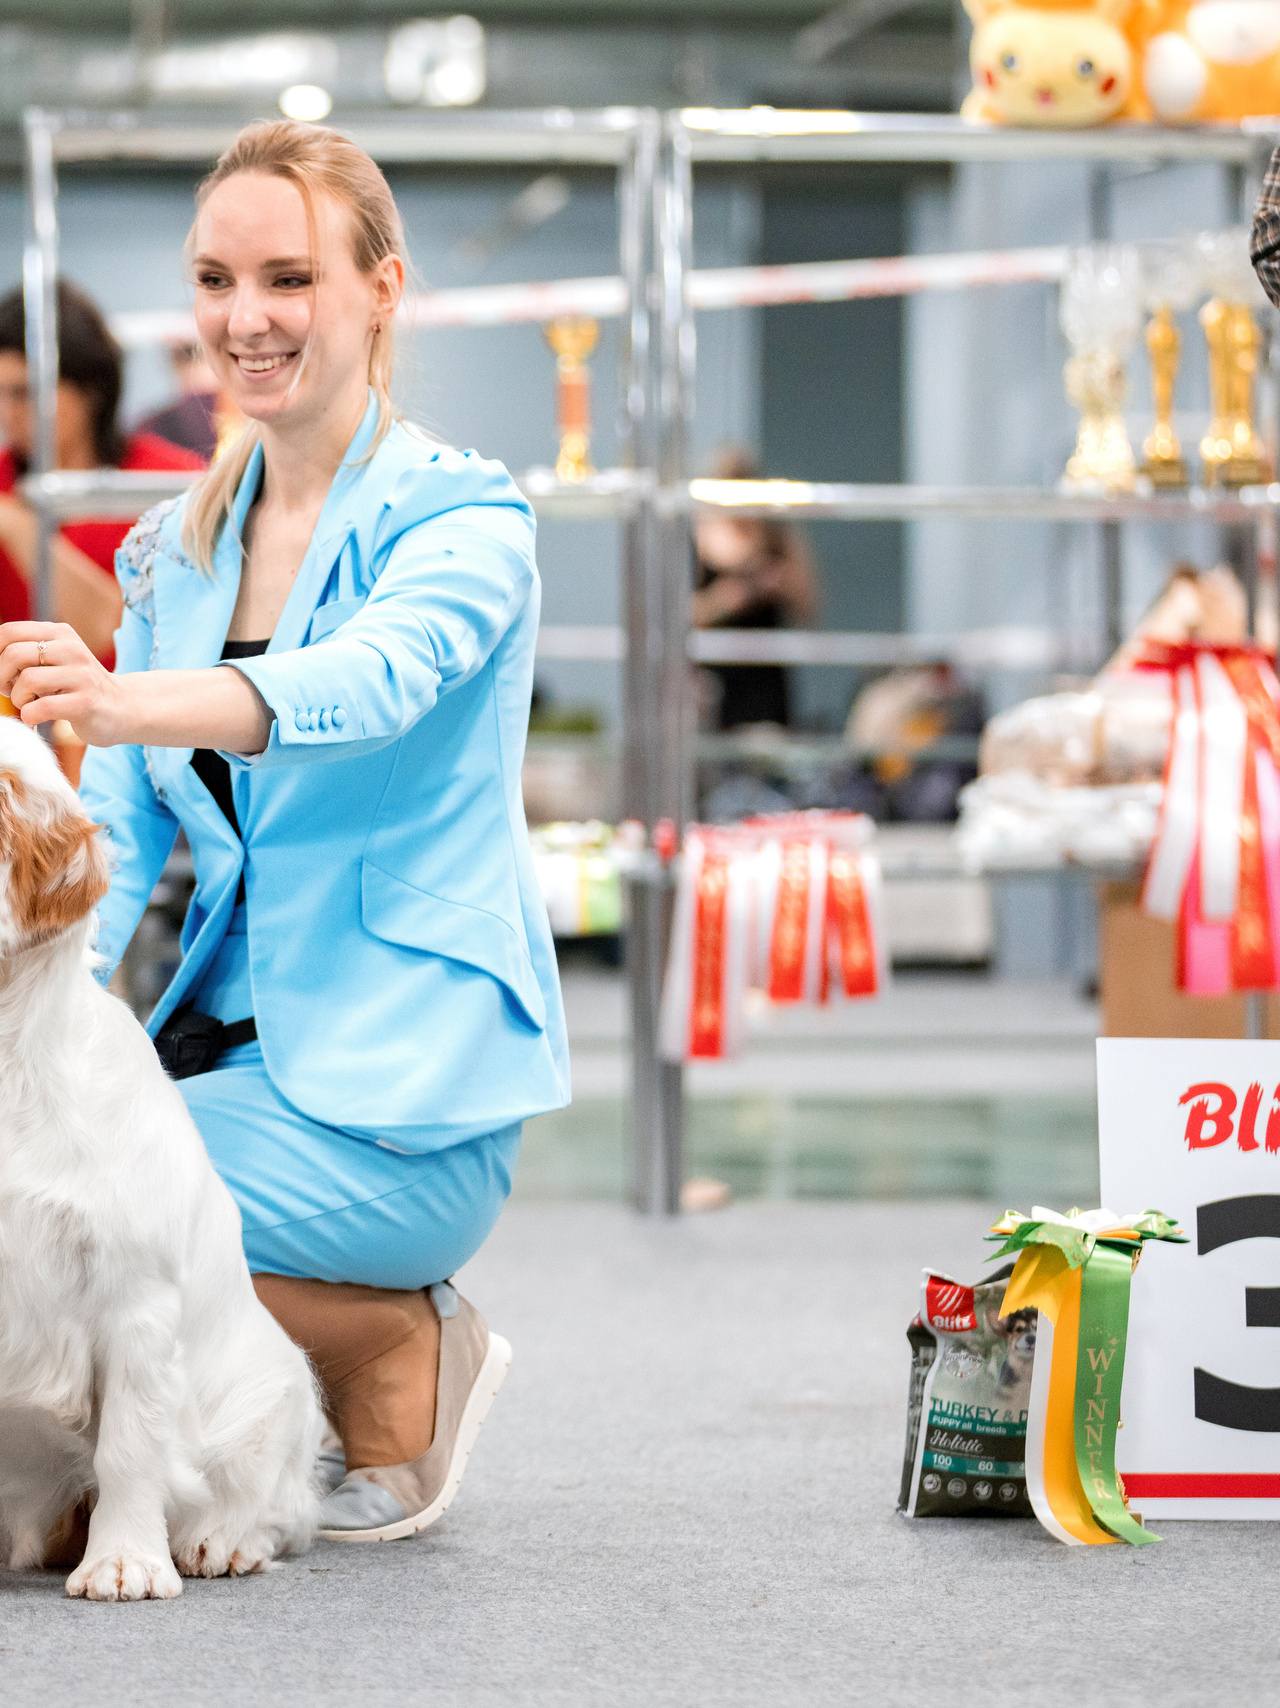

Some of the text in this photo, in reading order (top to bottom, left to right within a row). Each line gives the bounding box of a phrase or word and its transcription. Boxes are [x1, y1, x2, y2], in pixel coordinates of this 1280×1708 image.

[932, 1314, 972, 1330] Blitz
[929, 1396, 999, 1423] TURKEY
[932, 1414, 961, 1429] PUPPY
[962, 1421, 973, 1431] all
[1085, 1348, 1117, 1499] WINNER
[929, 1428, 985, 1454] Holistic
[933, 1453, 953, 1467] 100
[978, 1461, 994, 1472] 60
